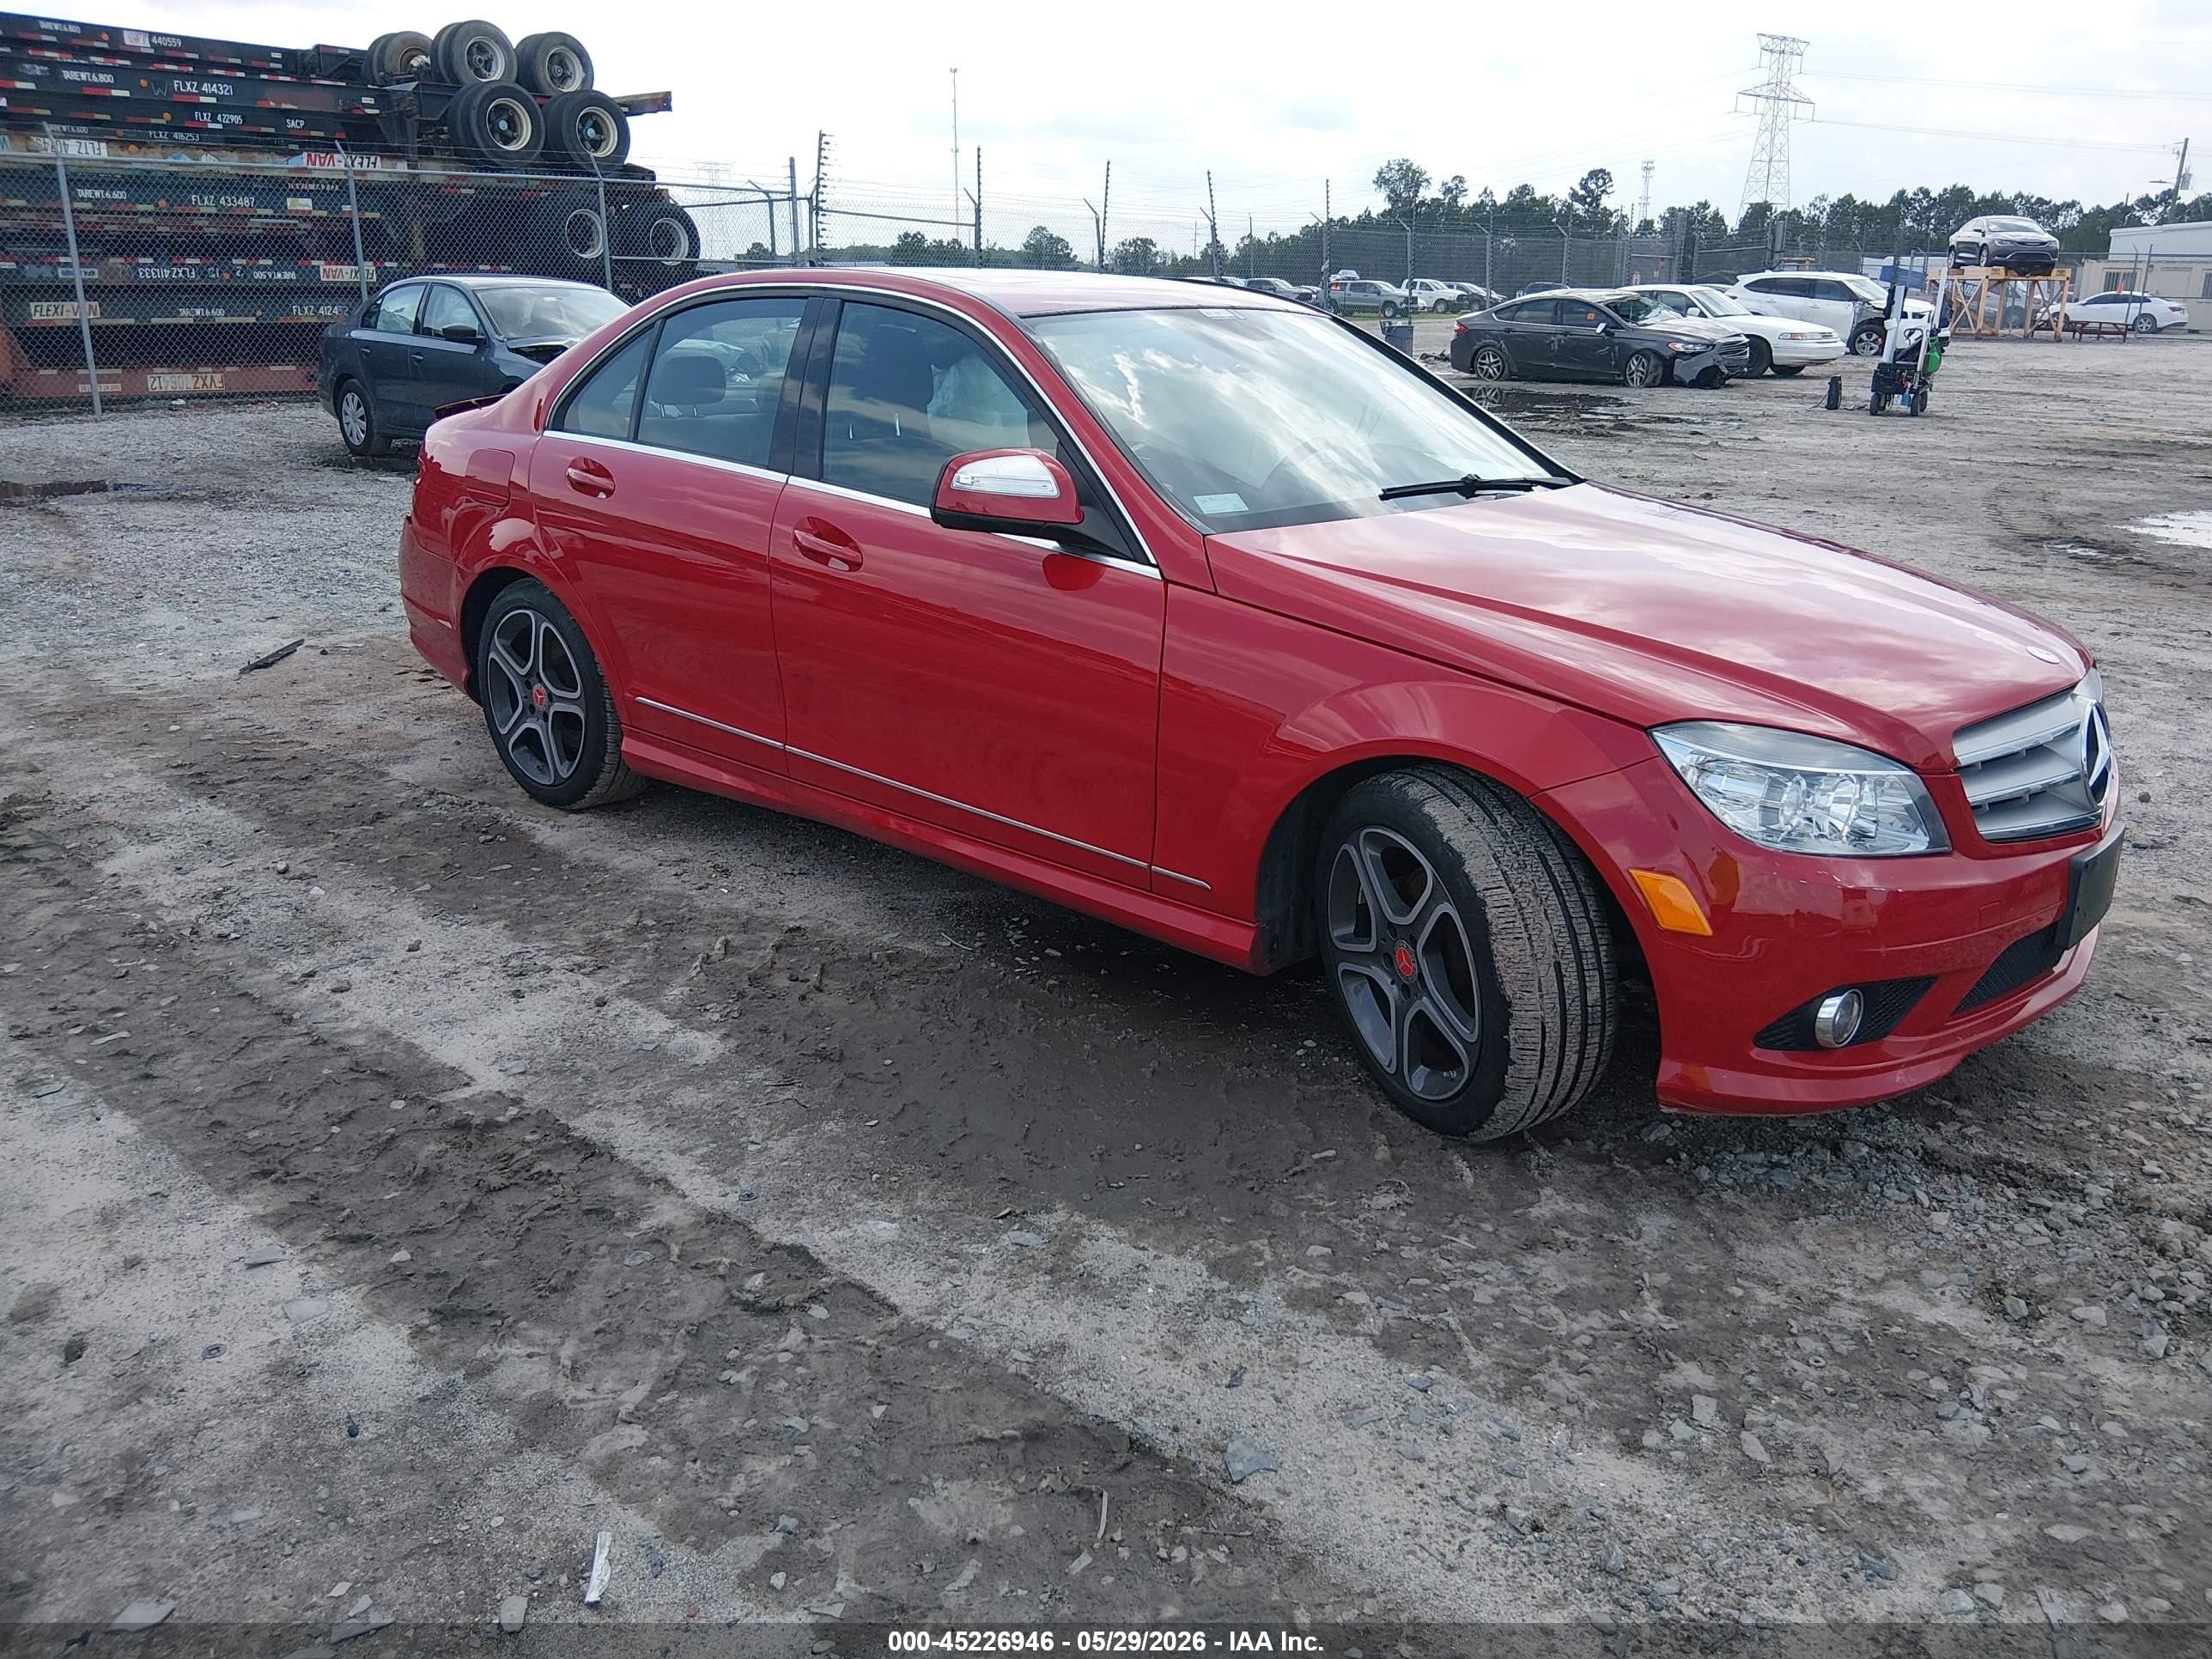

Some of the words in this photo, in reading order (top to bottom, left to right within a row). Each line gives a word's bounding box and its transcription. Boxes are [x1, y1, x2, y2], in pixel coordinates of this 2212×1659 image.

[152, 35, 182, 48] 440559
[173, 80, 199, 93] FLXZ
[201, 82, 234, 96] 414321
[194, 112, 212, 122] FLXZ
[216, 113, 243, 125] 422905
[286, 118, 305, 129] SACP
[76, 140, 101, 155] FLTZ
[191, 195, 216, 206] FLXZ
[219, 197, 255, 207] 433487
[322, 267, 375, 280] FLXI-VAN
[33, 304, 98, 317] FLEXI-VN
[292, 306, 315, 315] FLXZ
